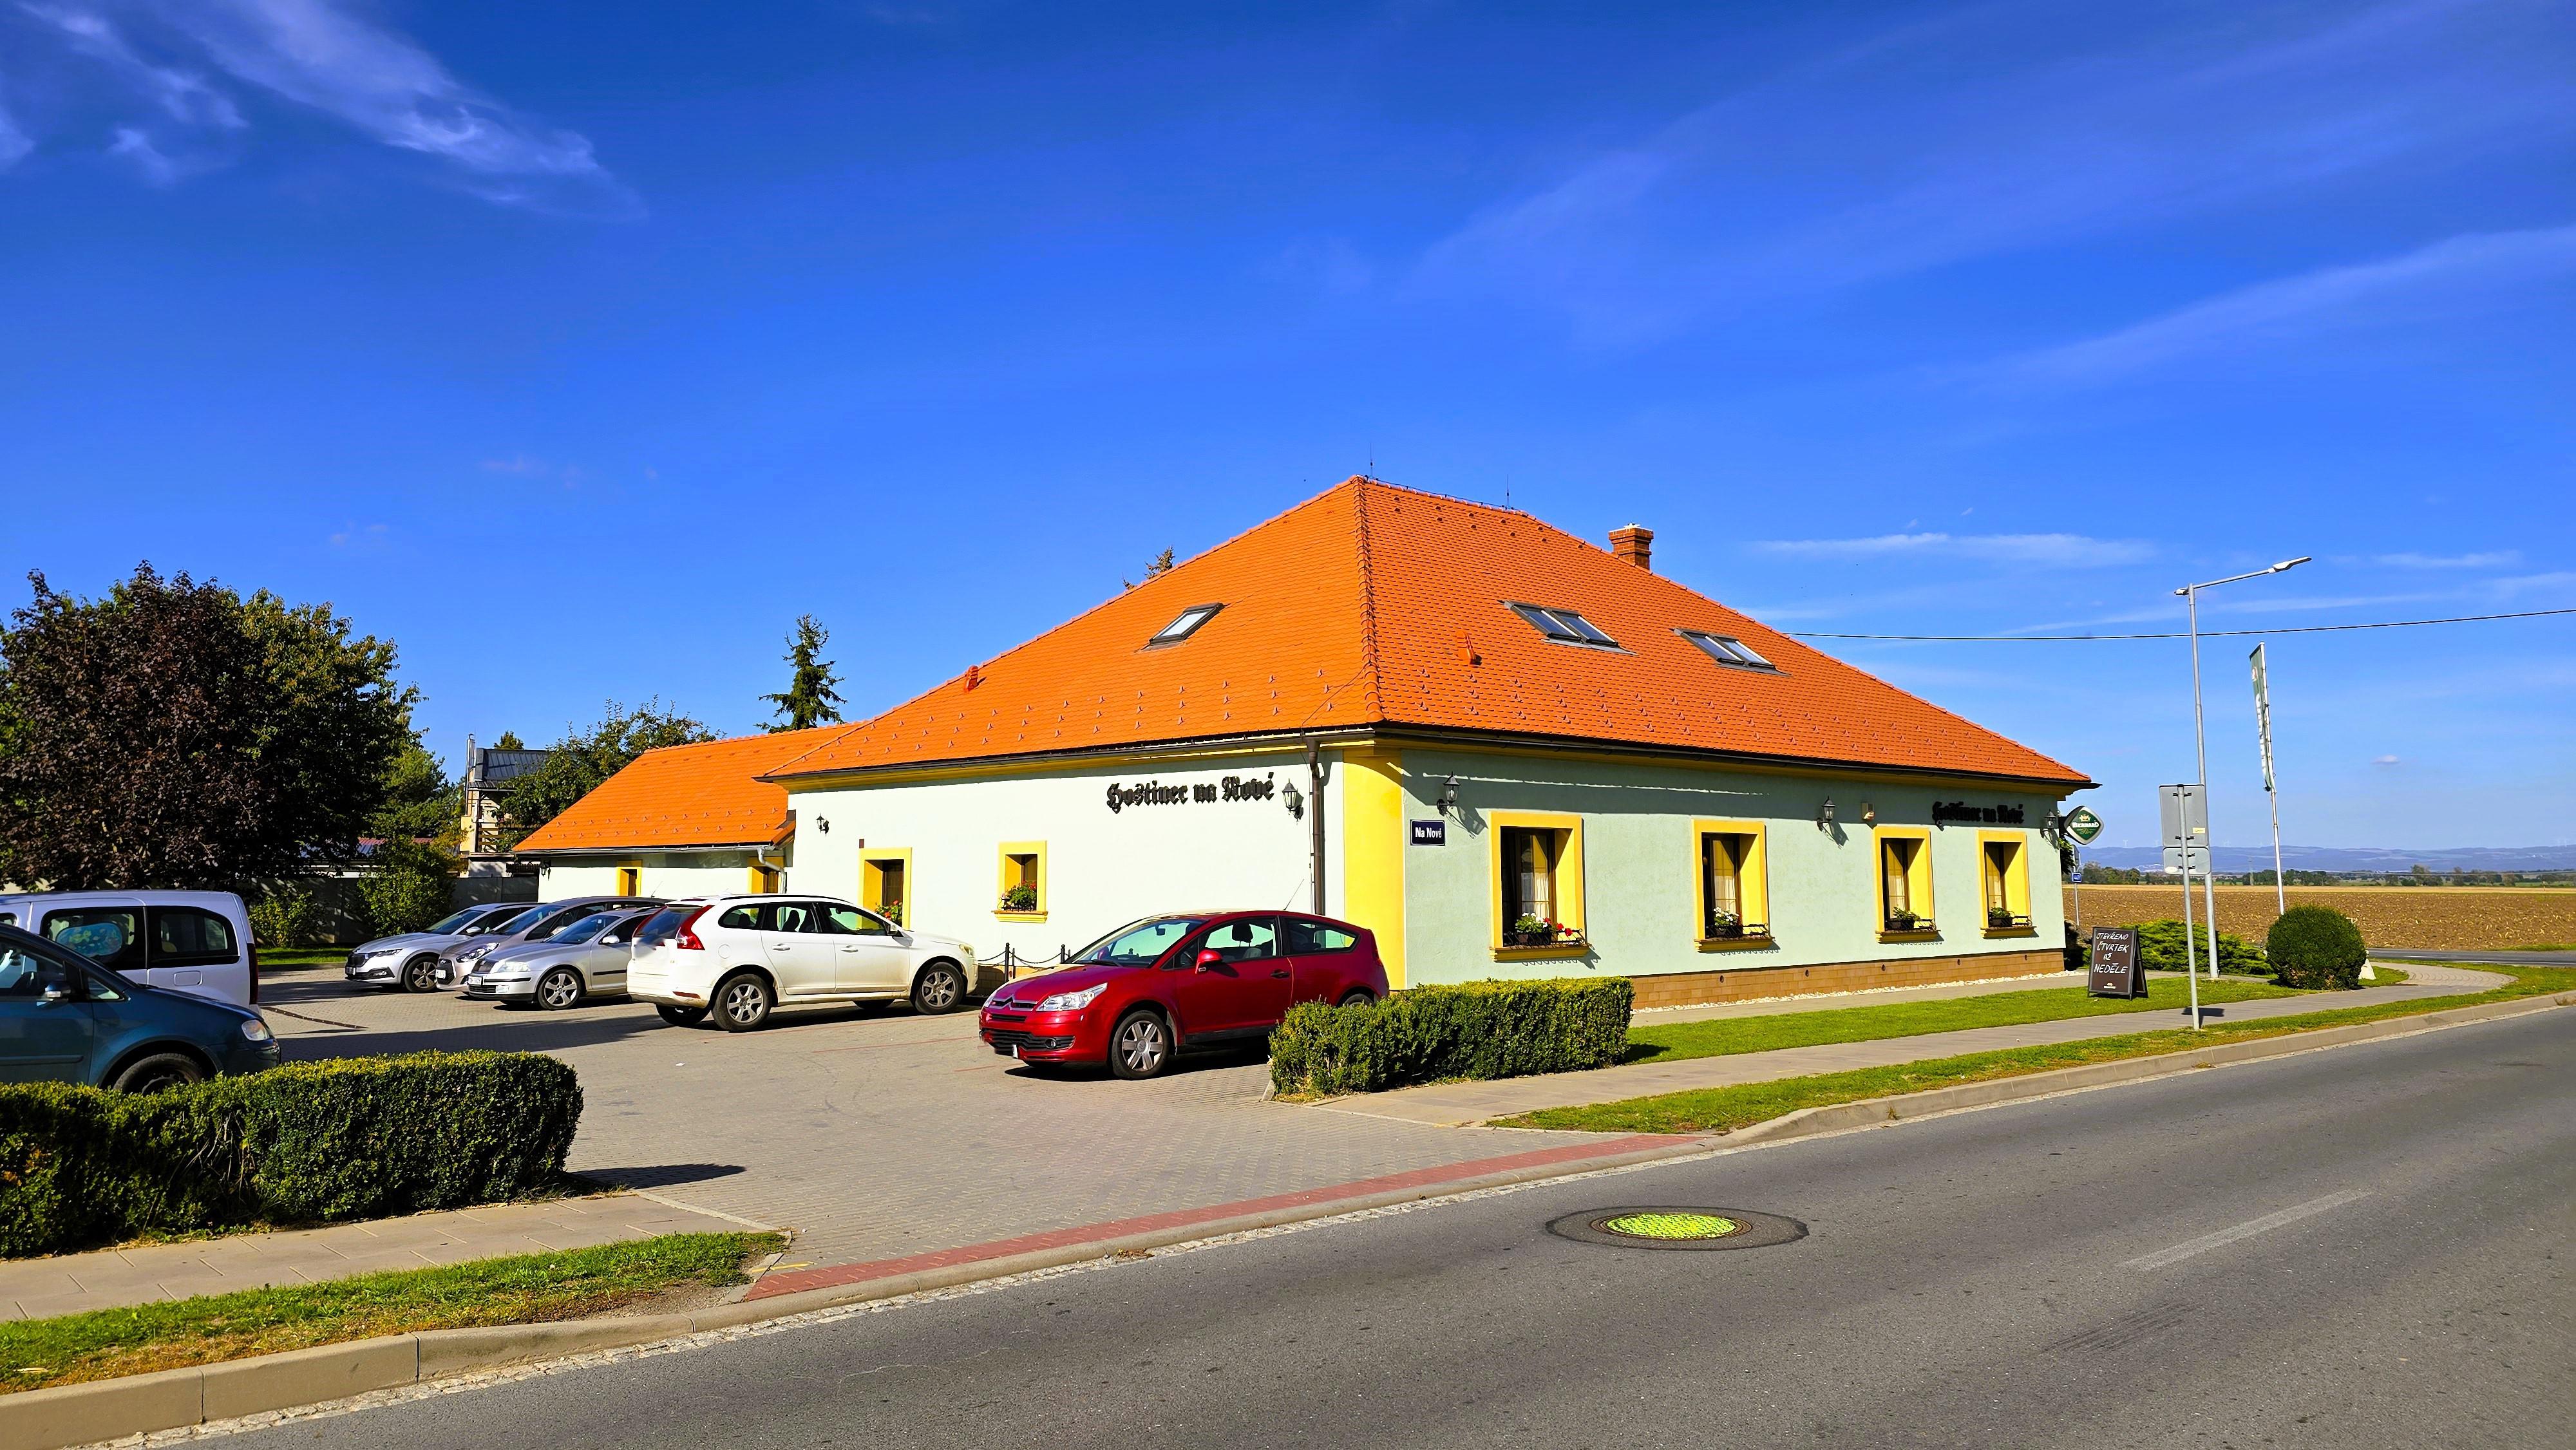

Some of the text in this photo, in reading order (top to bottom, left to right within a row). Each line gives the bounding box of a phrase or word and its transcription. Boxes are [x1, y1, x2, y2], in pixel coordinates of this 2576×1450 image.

[1193, 783, 1217, 804] na
[1221, 771, 1274, 802] Nové
[1415, 827, 1442, 838] Na Nové
[2096, 932, 2129, 940] OTEVŘENO
[2097, 941, 2130, 953] ČTVRTEK
[2103, 952, 2113, 961] AŽ
[2094, 963, 2128, 974] NEDĚLE
